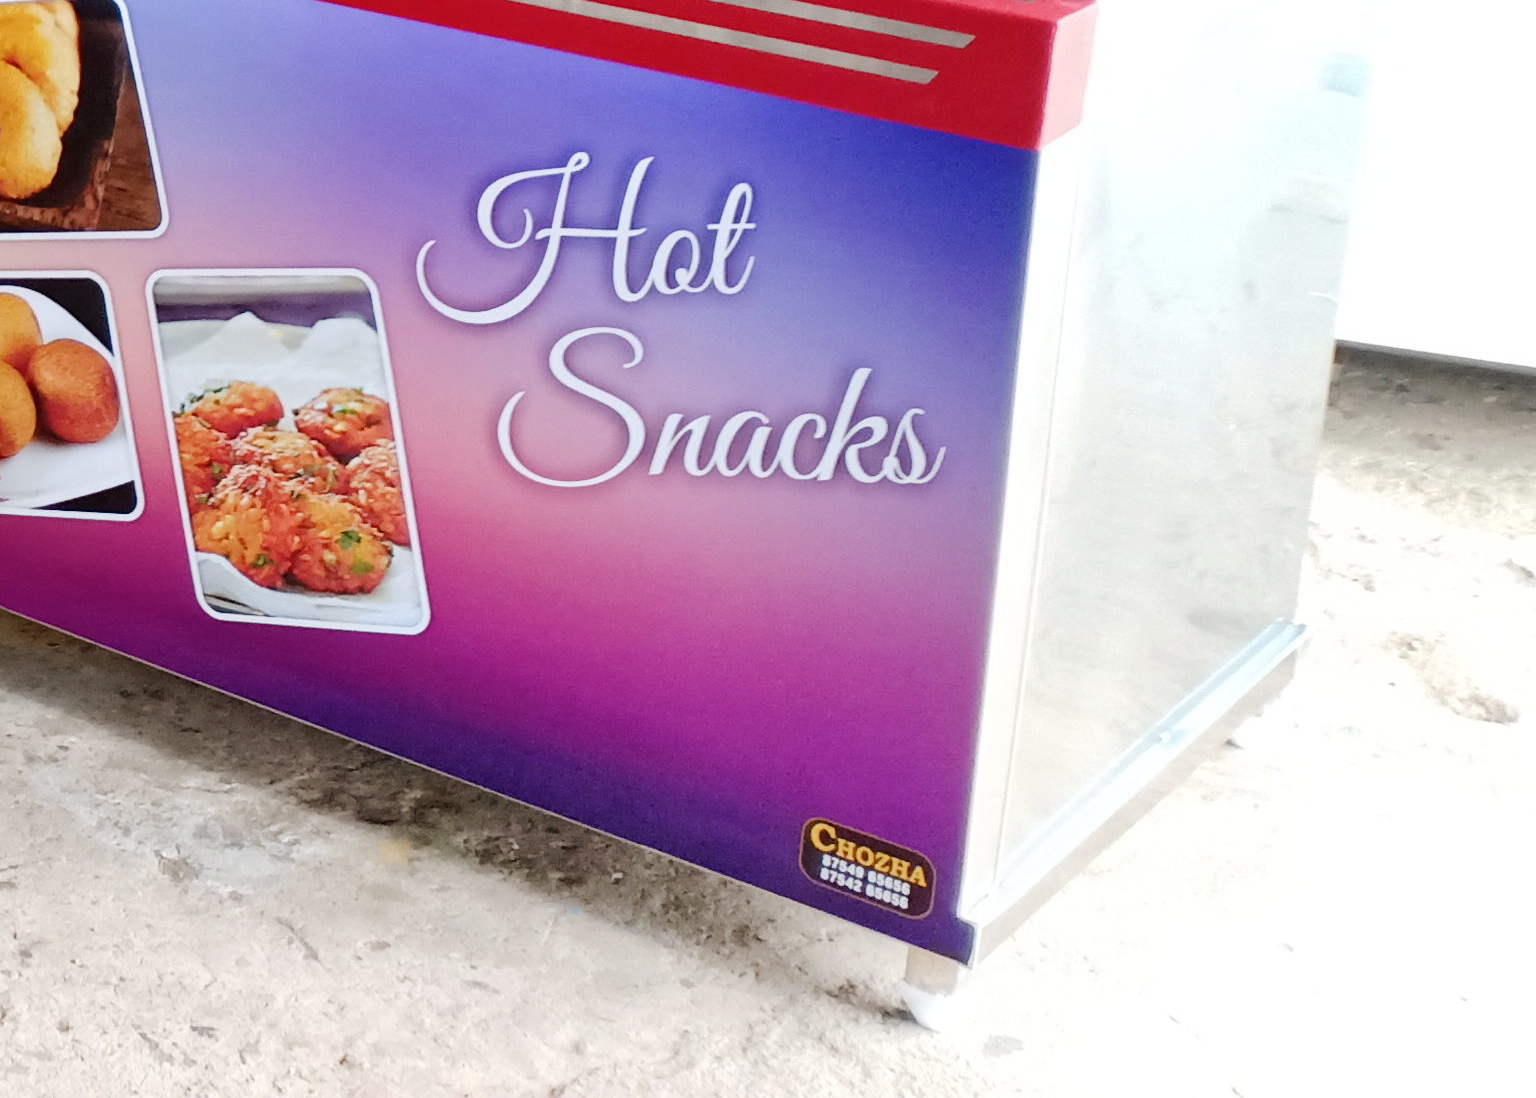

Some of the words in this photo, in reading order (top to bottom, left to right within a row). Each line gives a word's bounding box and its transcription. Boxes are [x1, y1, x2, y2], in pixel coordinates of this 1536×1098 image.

[415, 150, 757, 325] Hot
[496, 326, 947, 488] Snacks
[819, 867, 863, 893] 87542
[865, 883, 909, 910] 65656
[821, 853, 865, 880] 87549
[867, 870, 911, 896] 65656
